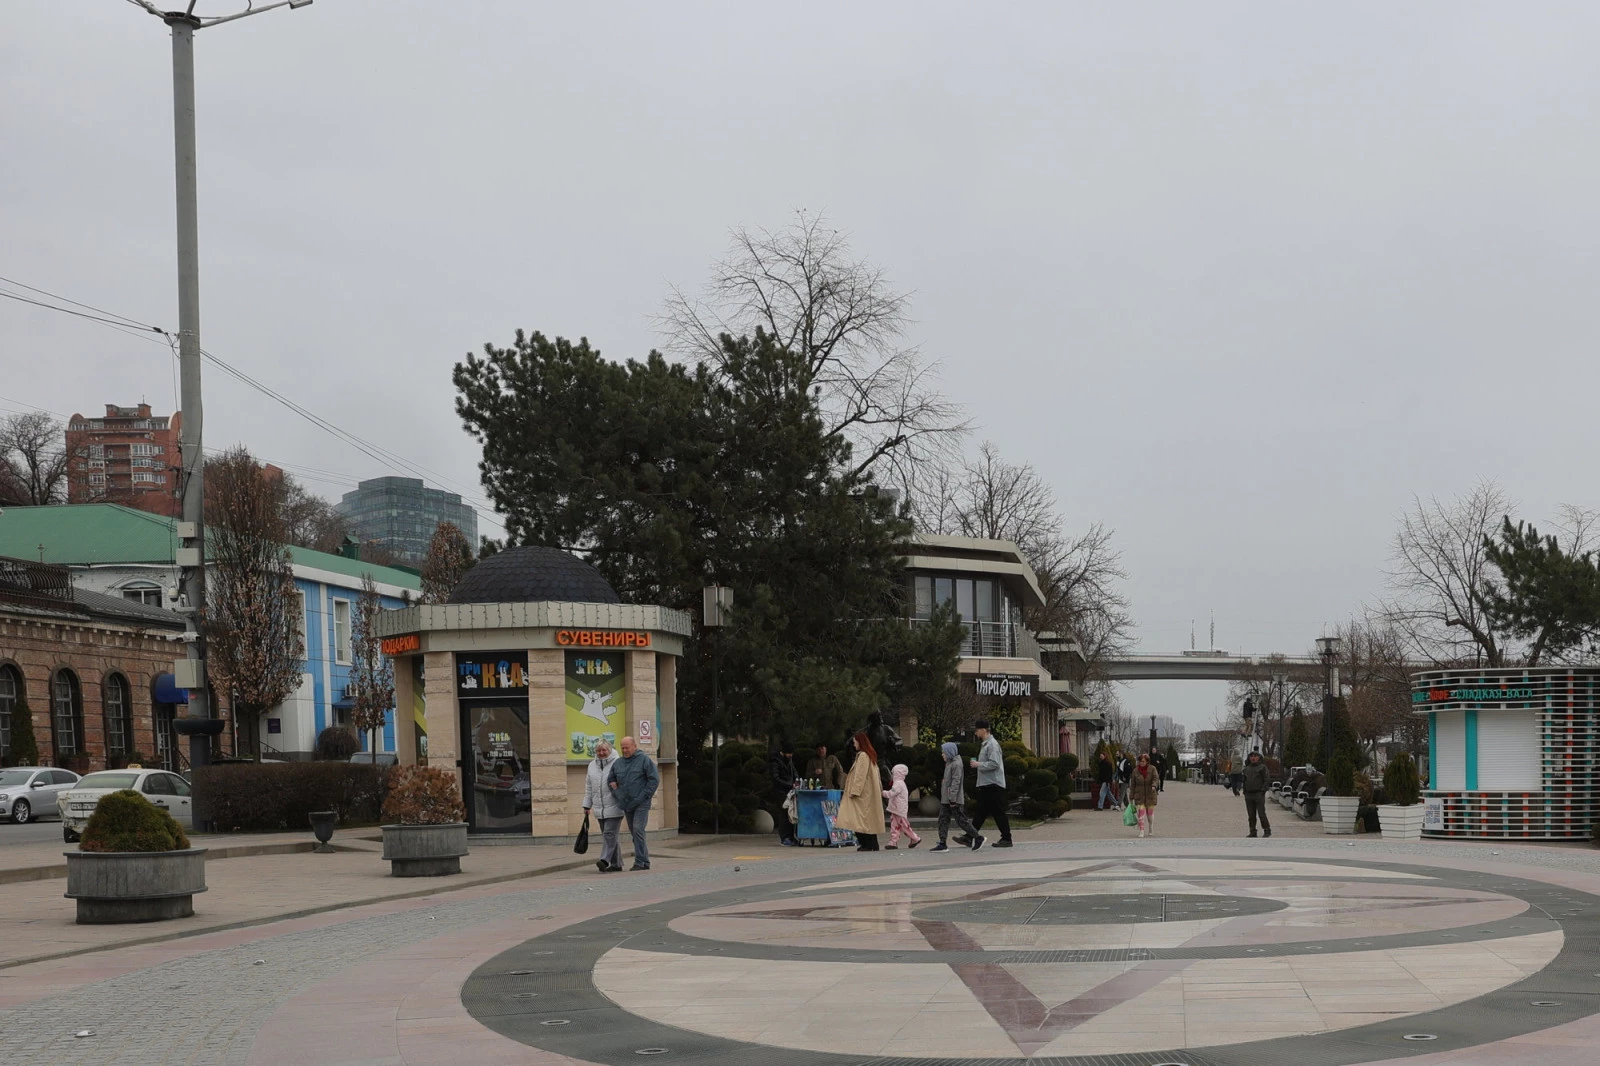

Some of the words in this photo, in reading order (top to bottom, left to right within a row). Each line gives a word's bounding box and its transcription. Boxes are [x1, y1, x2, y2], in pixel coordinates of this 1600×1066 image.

[557, 630, 652, 646] СУВЕНИРЫ
[458, 663, 481, 675] ТРИ
[1456, 689, 1502, 701] СЛАДКАЯ
[1506, 689, 1533, 699] ВАТА
